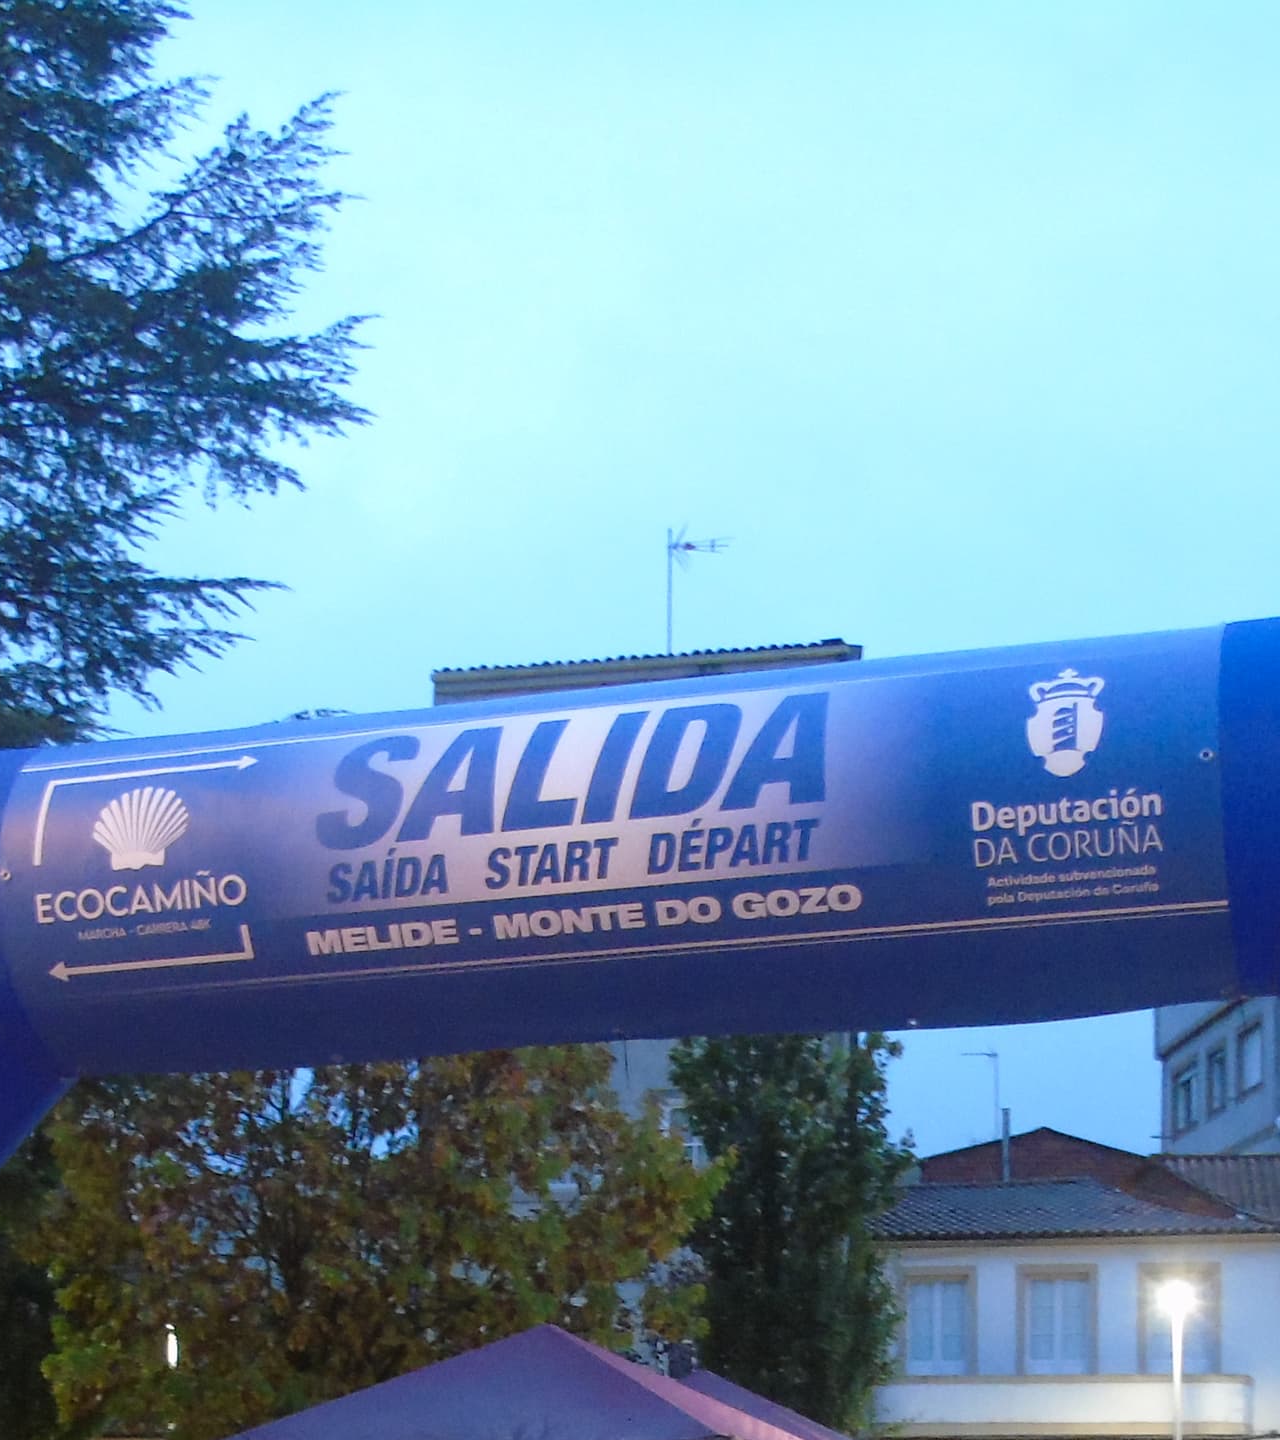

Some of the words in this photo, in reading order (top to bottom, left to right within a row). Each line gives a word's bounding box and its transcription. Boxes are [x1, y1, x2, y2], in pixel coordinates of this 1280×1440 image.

[317, 693, 827, 850] SALIDA
[971, 788, 1163, 836] Deputación
[327, 848, 448, 905] SAÍDA
[485, 837, 618, 890] START
[647, 818, 819, 875] DÉPART
[974, 837, 1017, 868] DA
[1028, 821, 1163, 862] CORUÑA
[35, 870, 247, 923] ECOCAMIÑO
[987, 872, 1056, 889] Actividade
[78, 927, 127, 940] MARCHA
[306, 919, 460, 957] MELIDE
[494, 903, 645, 942] MONTE
[656, 896, 721, 925] DO
[732, 883, 862, 920] GOZO
